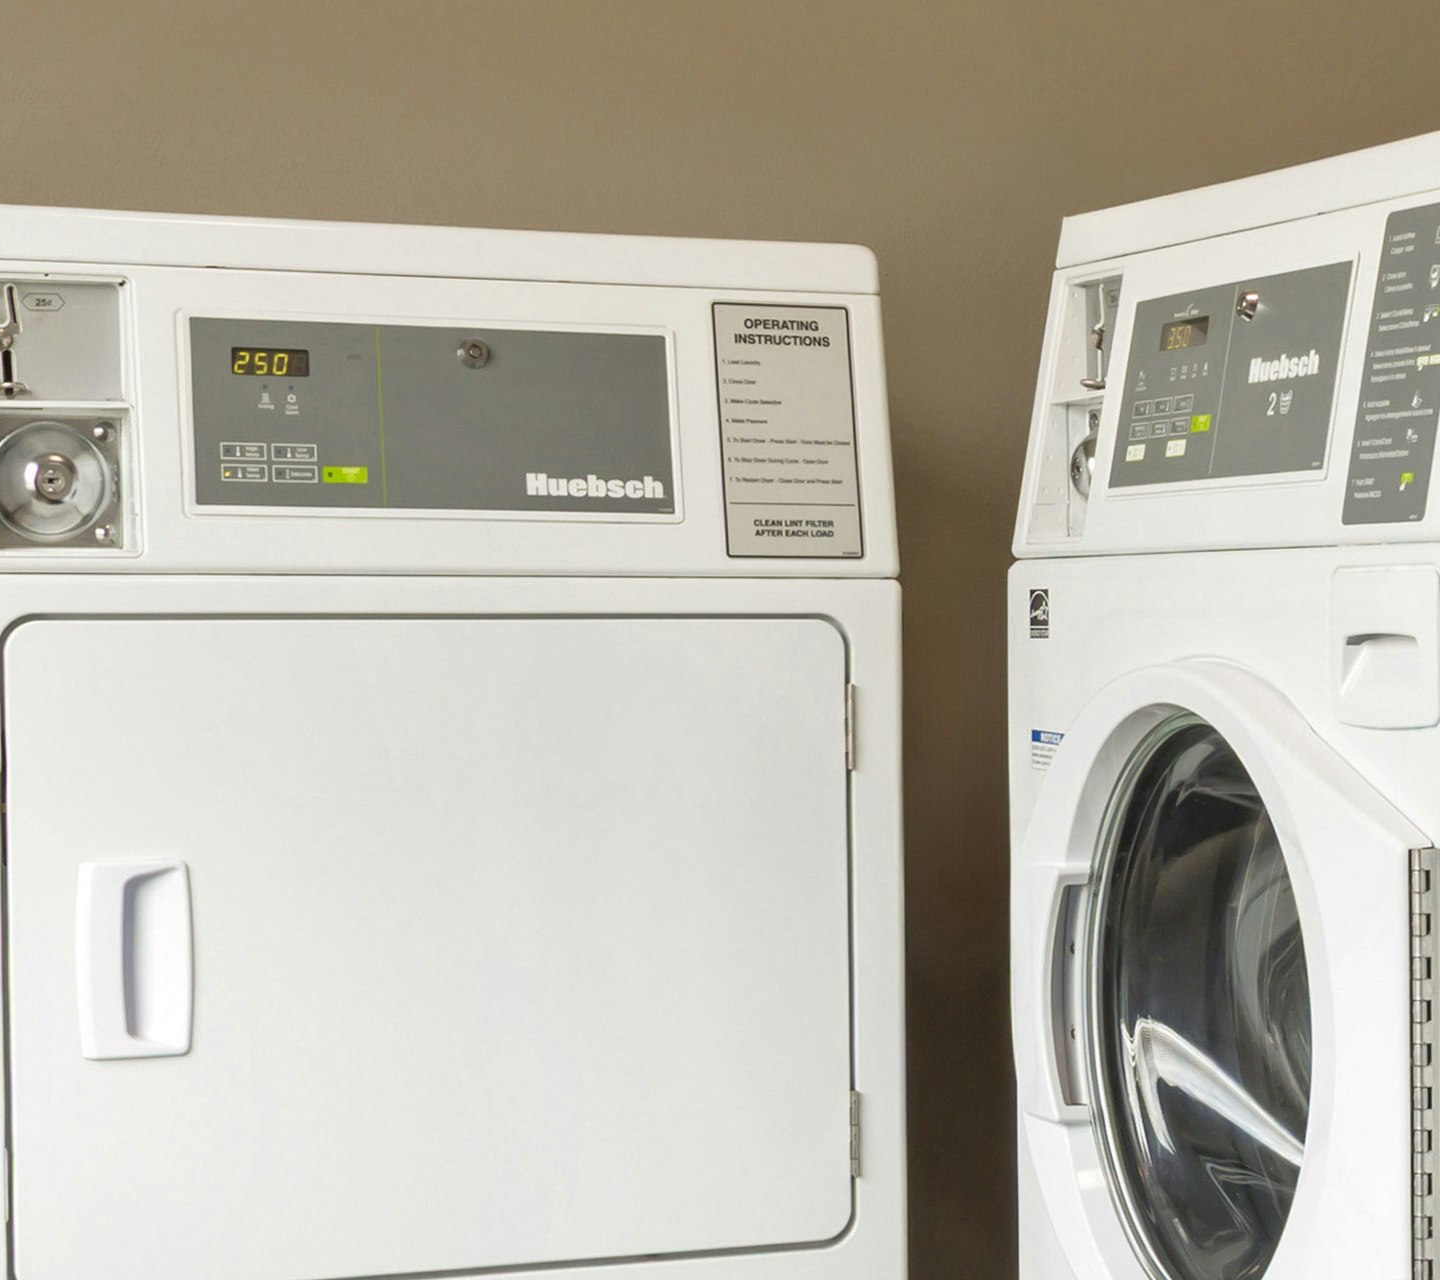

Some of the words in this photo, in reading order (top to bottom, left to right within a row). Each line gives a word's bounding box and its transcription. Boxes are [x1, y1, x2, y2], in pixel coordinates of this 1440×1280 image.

[744, 318, 819, 332] OPERATING
[734, 333, 830, 347] INSTRUCTIONS
[233, 351, 288, 375] 250
[1248, 349, 1319, 383] Huebsch
[1267, 392, 1276, 416] 2
[526, 473, 664, 498] Huebsch
